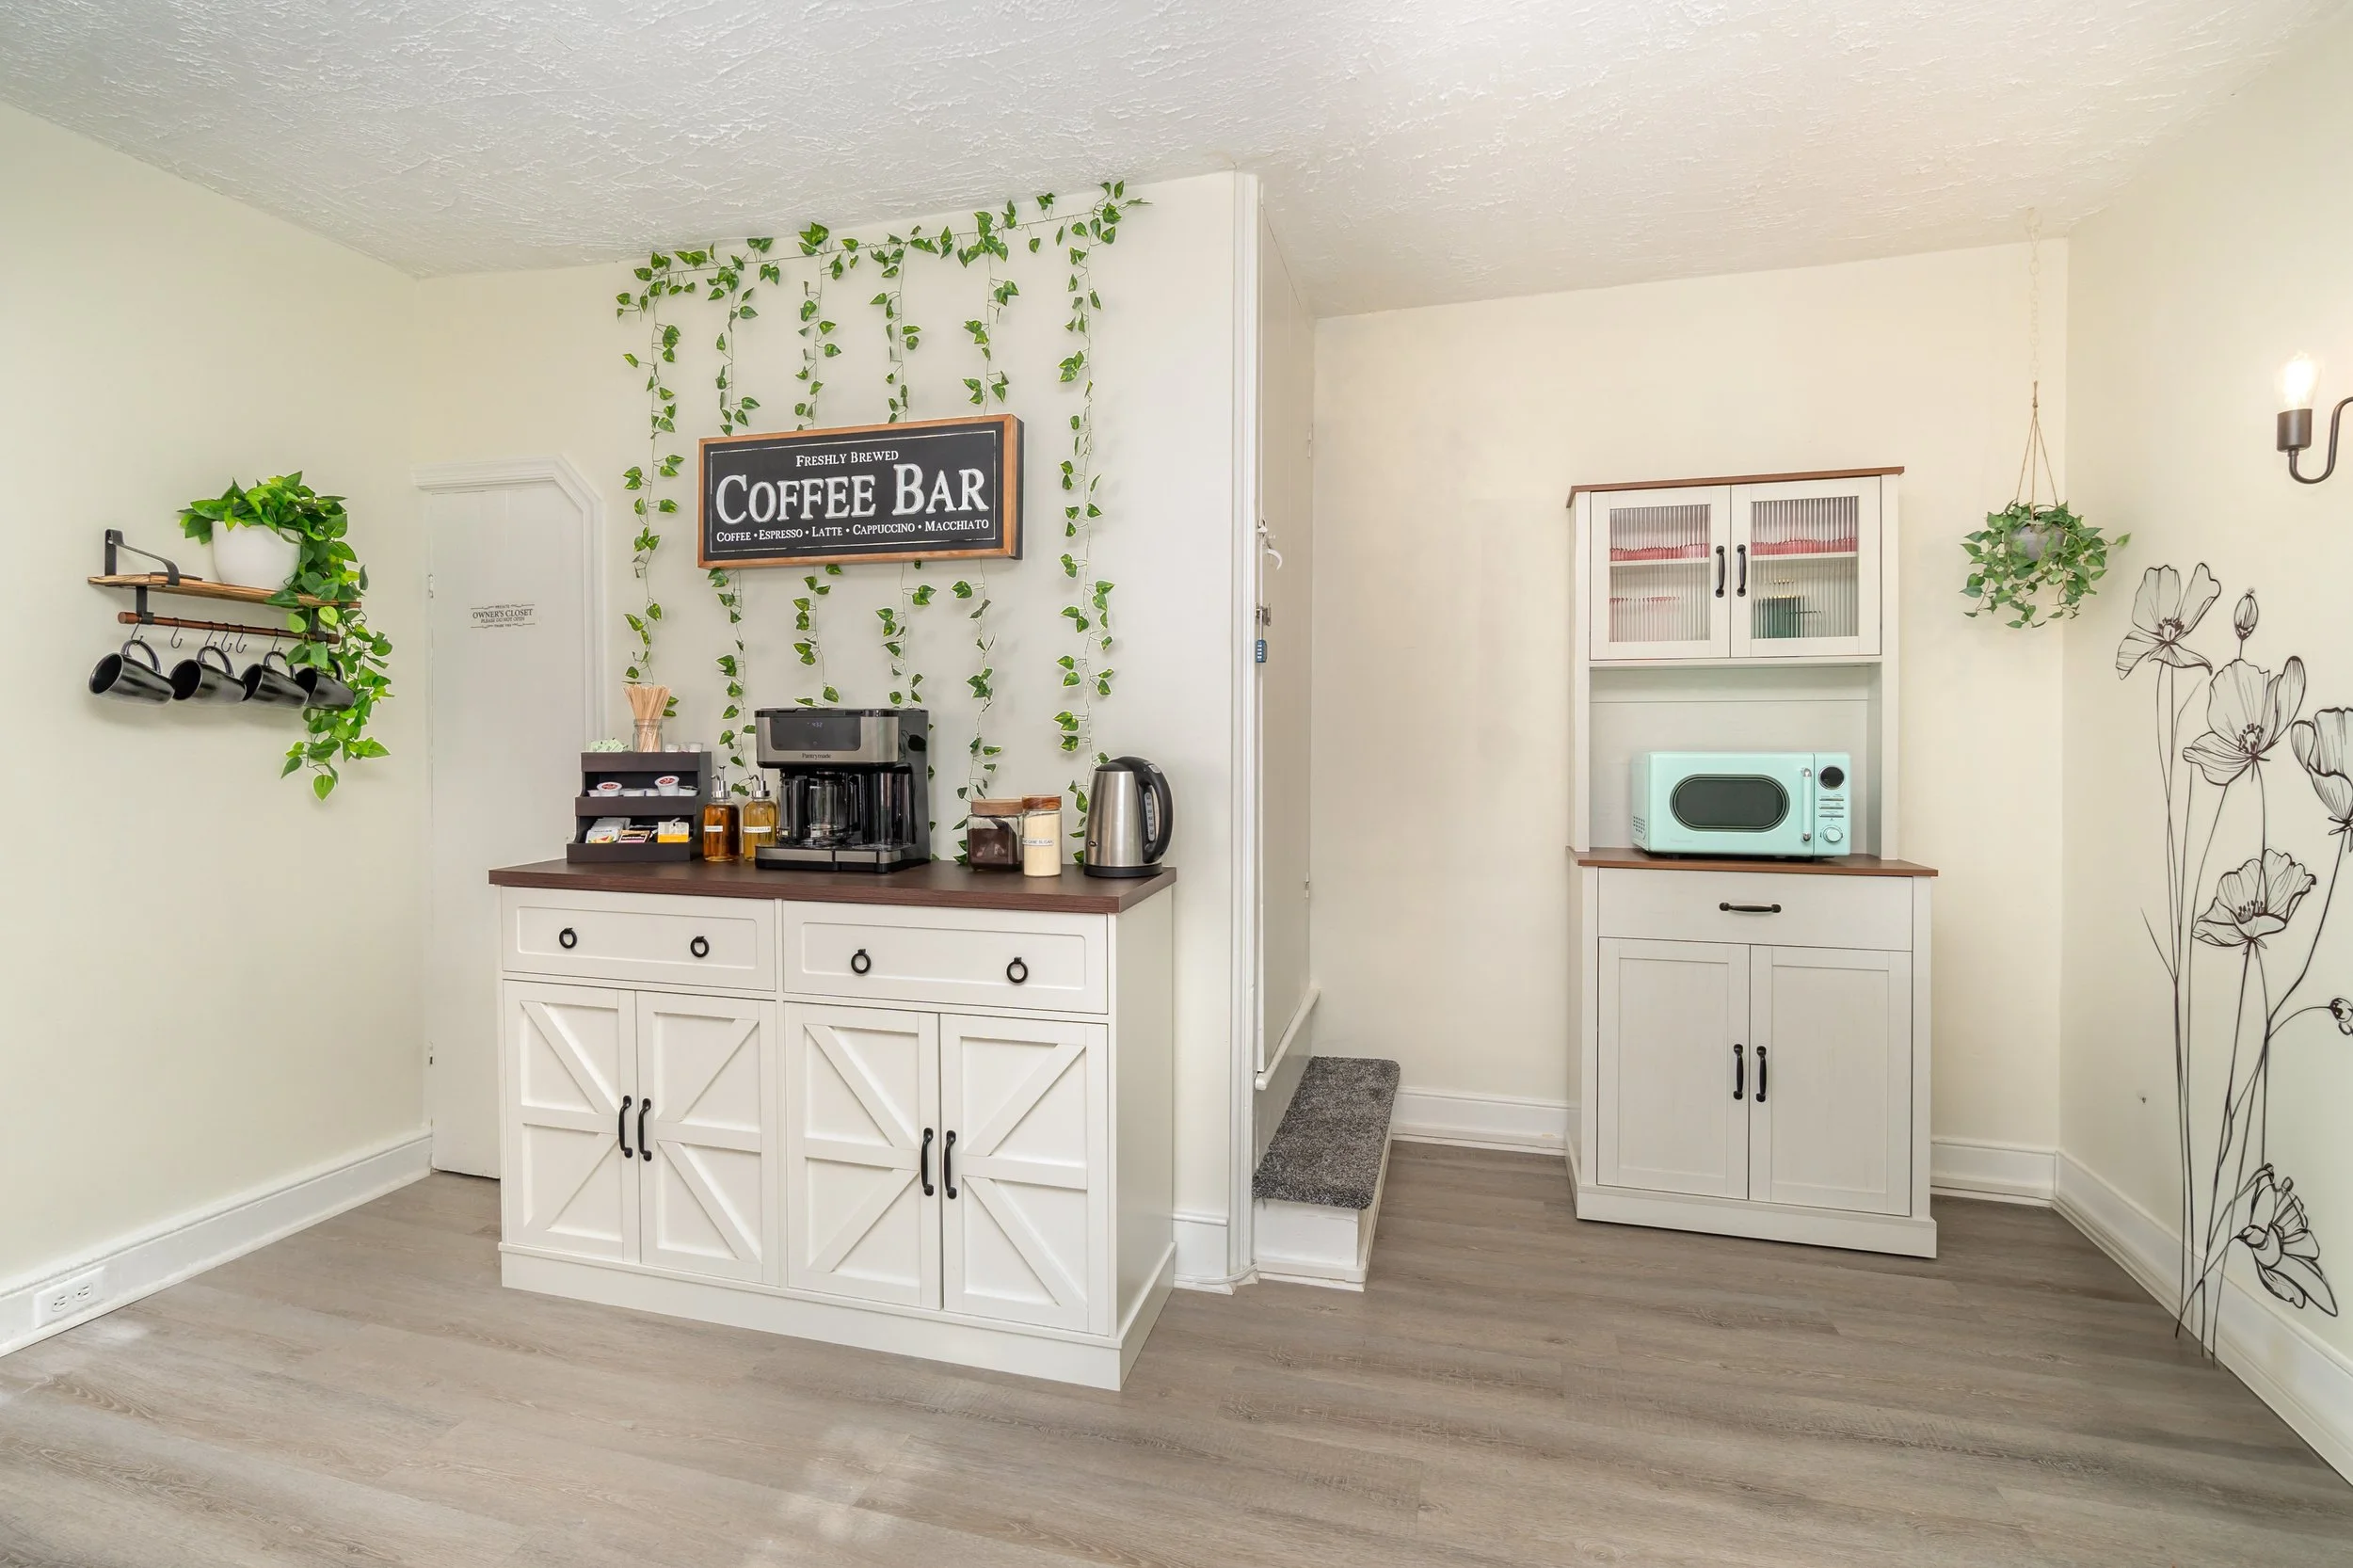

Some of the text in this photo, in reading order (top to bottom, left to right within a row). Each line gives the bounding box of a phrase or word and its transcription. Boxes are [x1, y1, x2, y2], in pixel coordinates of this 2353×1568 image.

[795, 450, 899, 467] FRESHLY BREWED
[715, 463, 989, 524] COFFEE BAR
[716, 519, 989, 542] COFFEE ESPRESSO LATTE CAPPUCCINO MACCHIATO
[472, 608, 533, 618] OWNER'S CLOSET
